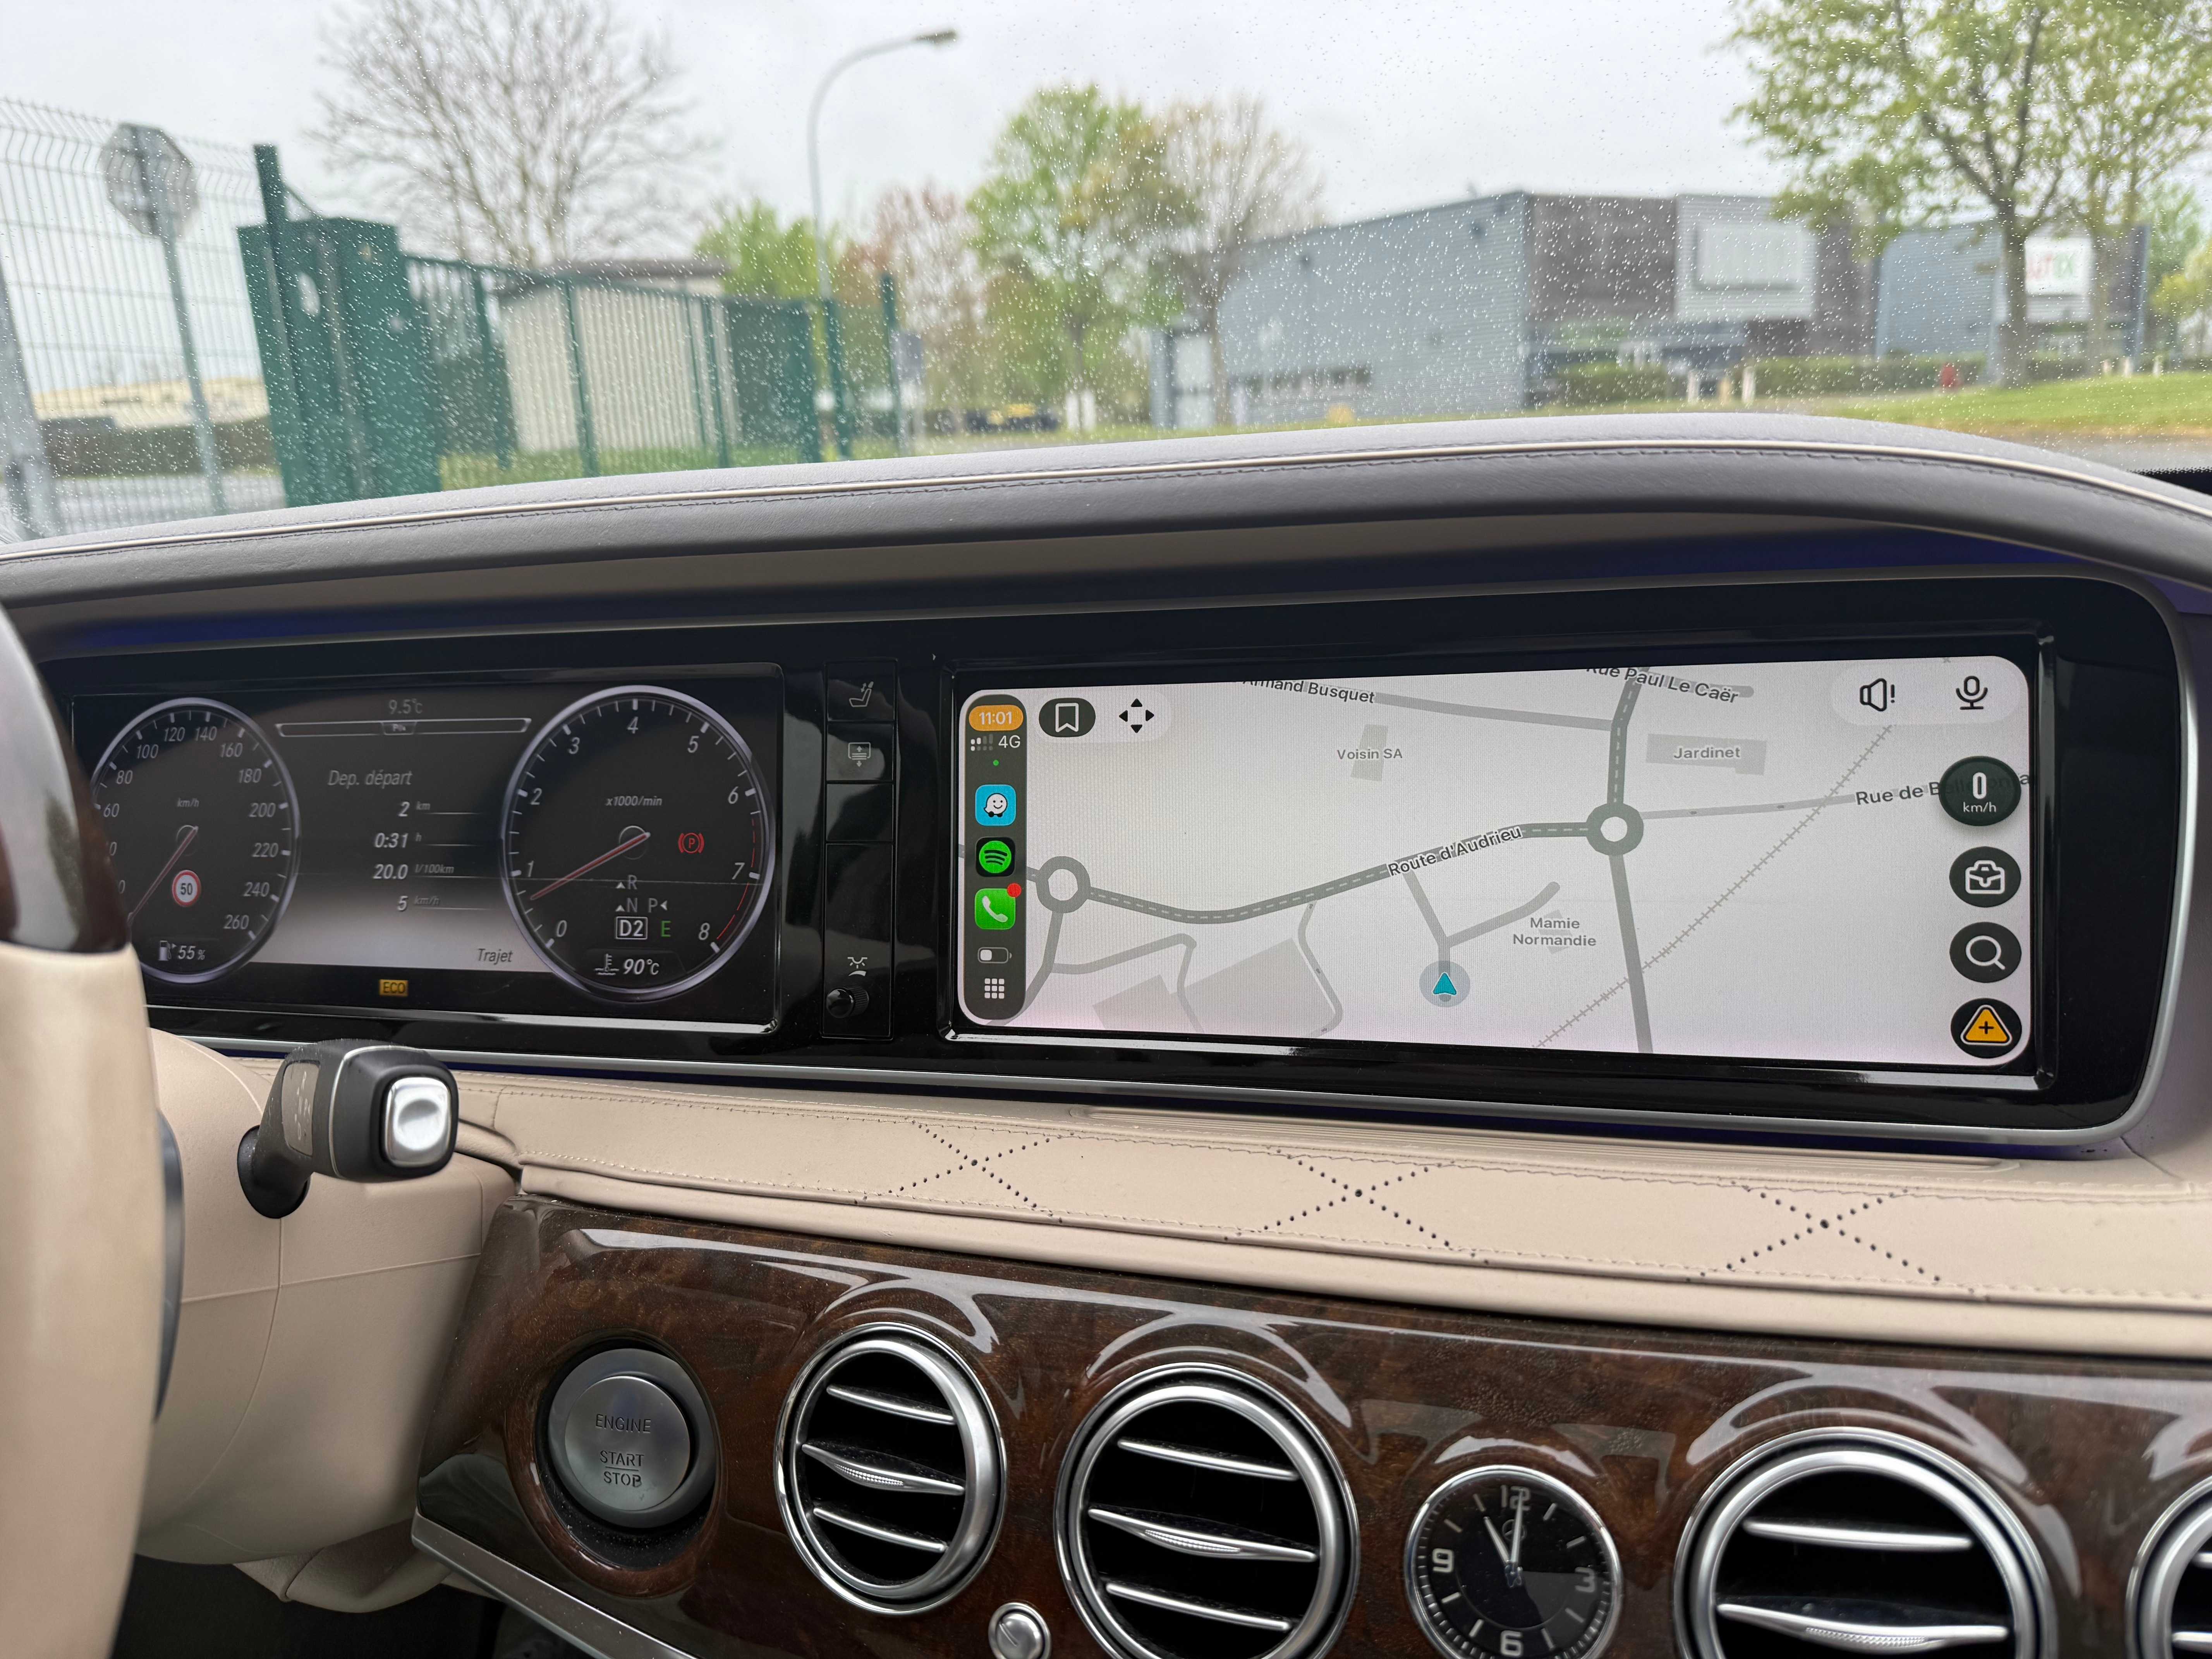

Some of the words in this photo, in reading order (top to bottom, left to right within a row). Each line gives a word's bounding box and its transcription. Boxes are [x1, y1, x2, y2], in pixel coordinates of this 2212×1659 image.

[1308, 682, 1375, 703] Busquet
[1625, 668, 1664, 687] Paul
[1668, 677, 1690, 692] Le
[1695, 683, 1738, 703] Caër
[979, 711, 1012, 725] 11:01
[195, 726, 217, 740] 140
[627, 719, 639, 734] 4
[163, 728, 185, 742] 120
[998, 735, 1021, 749] 4G
[137, 745, 159, 758] 100
[220, 743, 243, 757] 160
[569, 738, 580, 754] 3
[687, 736, 699, 753] 5
[1337, 749, 1379, 760] Voisin
[1383, 748, 1403, 759] SA
[1674, 747, 1741, 759] Jardinet
[117, 771, 132, 784] 80
[239, 769, 261, 783] 180
[328, 770, 359, 789] Dep.
[366, 769, 413, 788] départ
[1973, 772, 1986, 799] 0
[177, 798, 199, 807] km/h
[531, 788, 543, 805] 2
[605, 796, 662, 807] x1000/min
[728, 787, 738, 804] 6
[1855, 790, 1893, 805] Rue
[1899, 786, 1923, 800] de
[104, 804, 119, 817] 60
[249, 804, 275, 817] 200
[398, 801, 410, 817] 2
[416, 801, 430, 810] km
[1963, 802, 1996, 812] km/h
[375, 832, 408, 848] 0:31
[415, 833, 422, 842] h
[689, 838, 696, 848] P
[252, 843, 278, 857] 220
[1388, 854, 1437, 876] Route
[1440, 826, 1523, 860] d'Audrieu
[373, 864, 408, 879] 20.0
[527, 862, 534, 877] 1
[732, 863, 745, 879] 7
[180, 884, 193, 895] 50
[244, 883, 270, 897] 240
[628, 875, 637, 890] R
[397, 895, 408, 911] 5
[627, 898, 638, 912] N
[648, 898, 658, 912] P
[224, 915, 249, 929] 260
[556, 920, 567, 937] 0
[620, 920, 643, 936] D2
[661, 921, 672, 937] E
[1530, 917, 1580, 929] Mamie
[699, 923, 710, 940] 8
[1513, 934, 1597, 946] Normandie
[477, 948, 513, 963] Trajet
[383, 982, 406, 994] ECO
[596, 1414, 652, 1433] ENGINE
[600, 1451, 644, 1467] START
[1501, 1485, 1531, 1511] 12
[1433, 1548, 1454, 1573] 9
[1575, 1567, 1595, 1592] 3
[1500, 1630, 1523, 1657] 6
